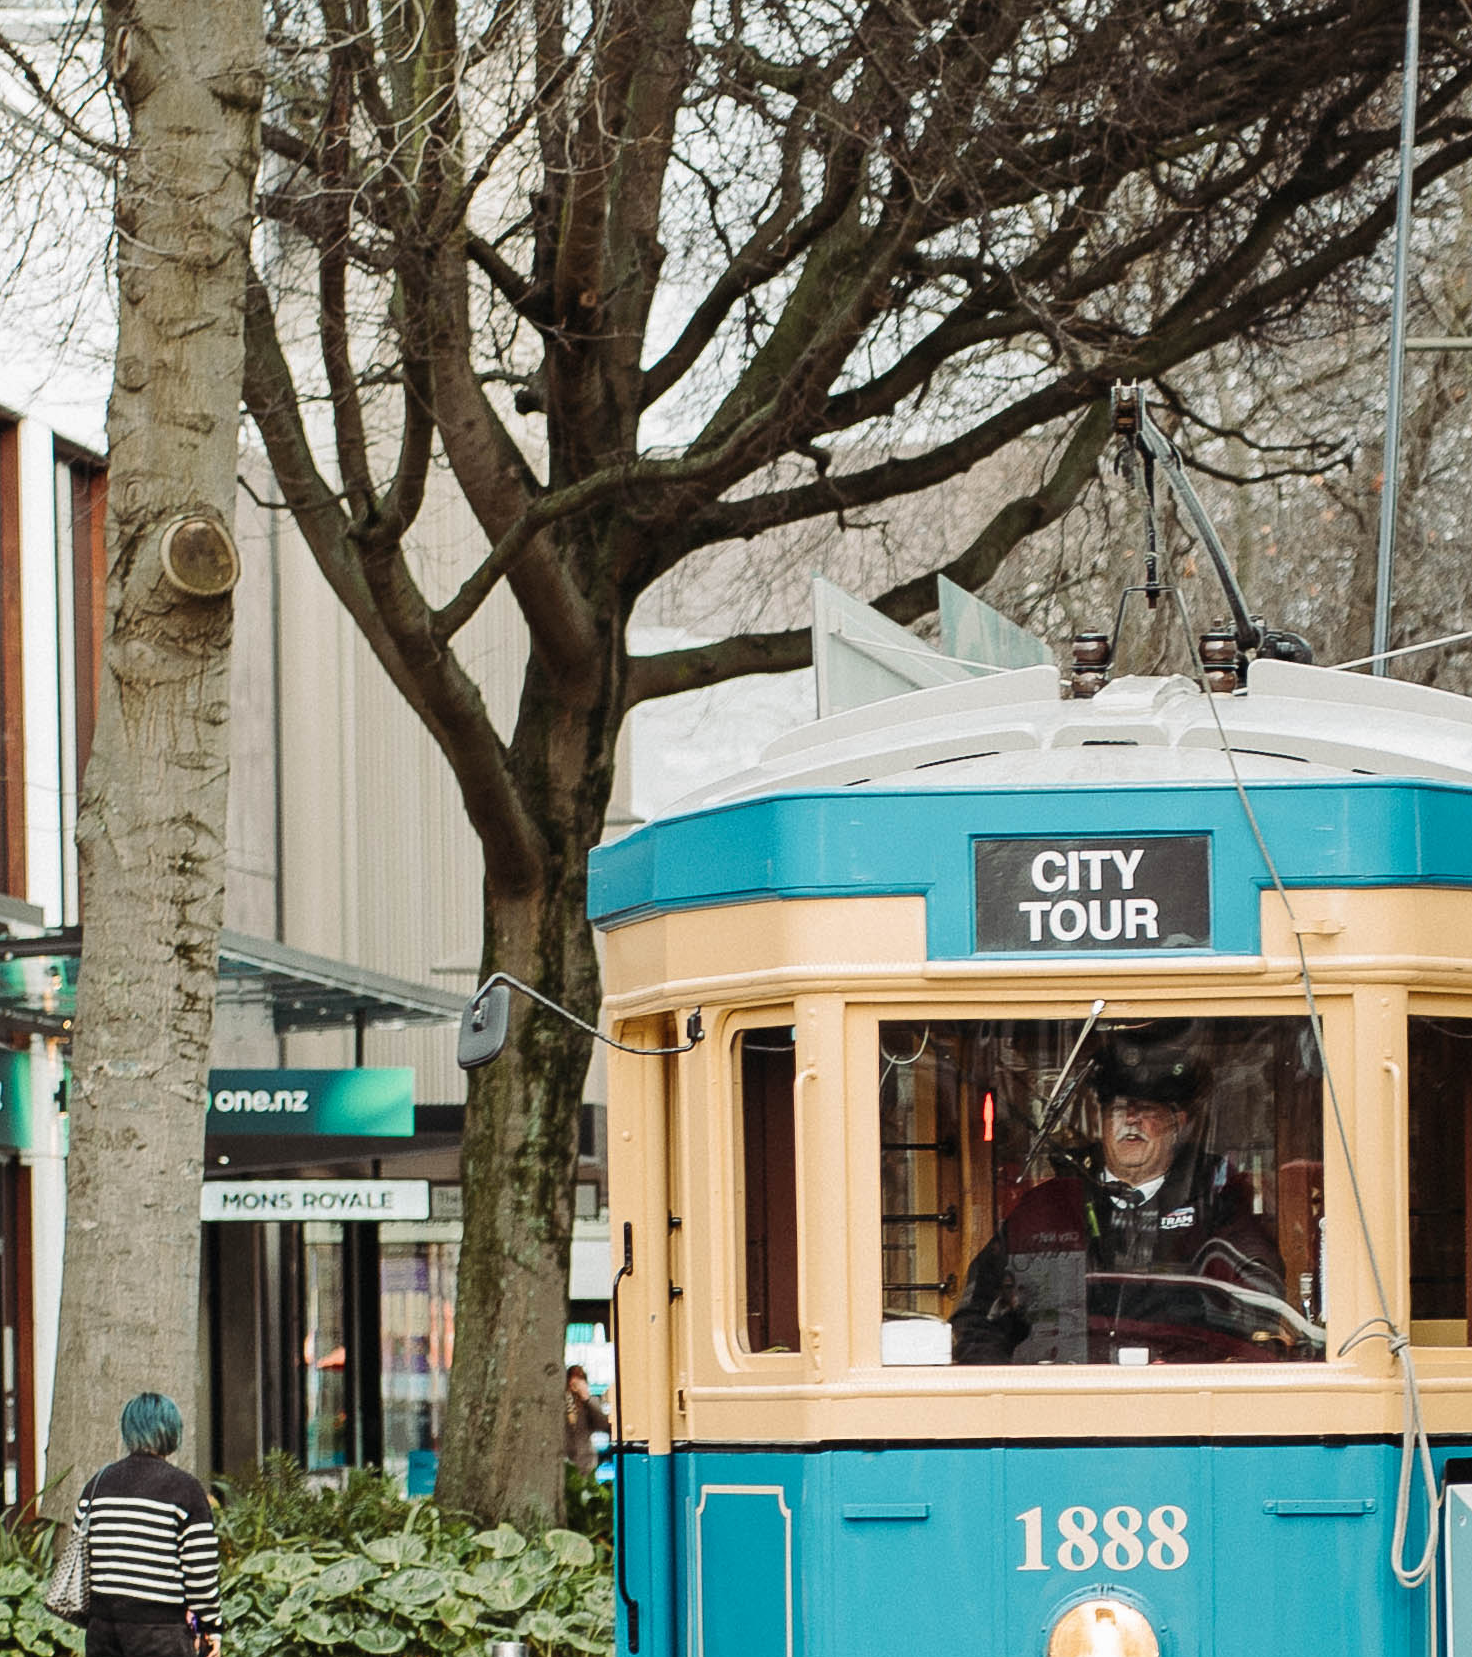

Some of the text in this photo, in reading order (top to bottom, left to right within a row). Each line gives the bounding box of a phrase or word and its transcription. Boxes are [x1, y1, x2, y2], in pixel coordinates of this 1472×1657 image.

[1031, 849, 1145, 893] CITY
[1018, 898, 1160, 943] TOUR
[214, 1090, 310, 1112] one.nz
[222, 1191, 395, 1210] MONS ROYALE
[1015, 1505, 1189, 1571] 1888
